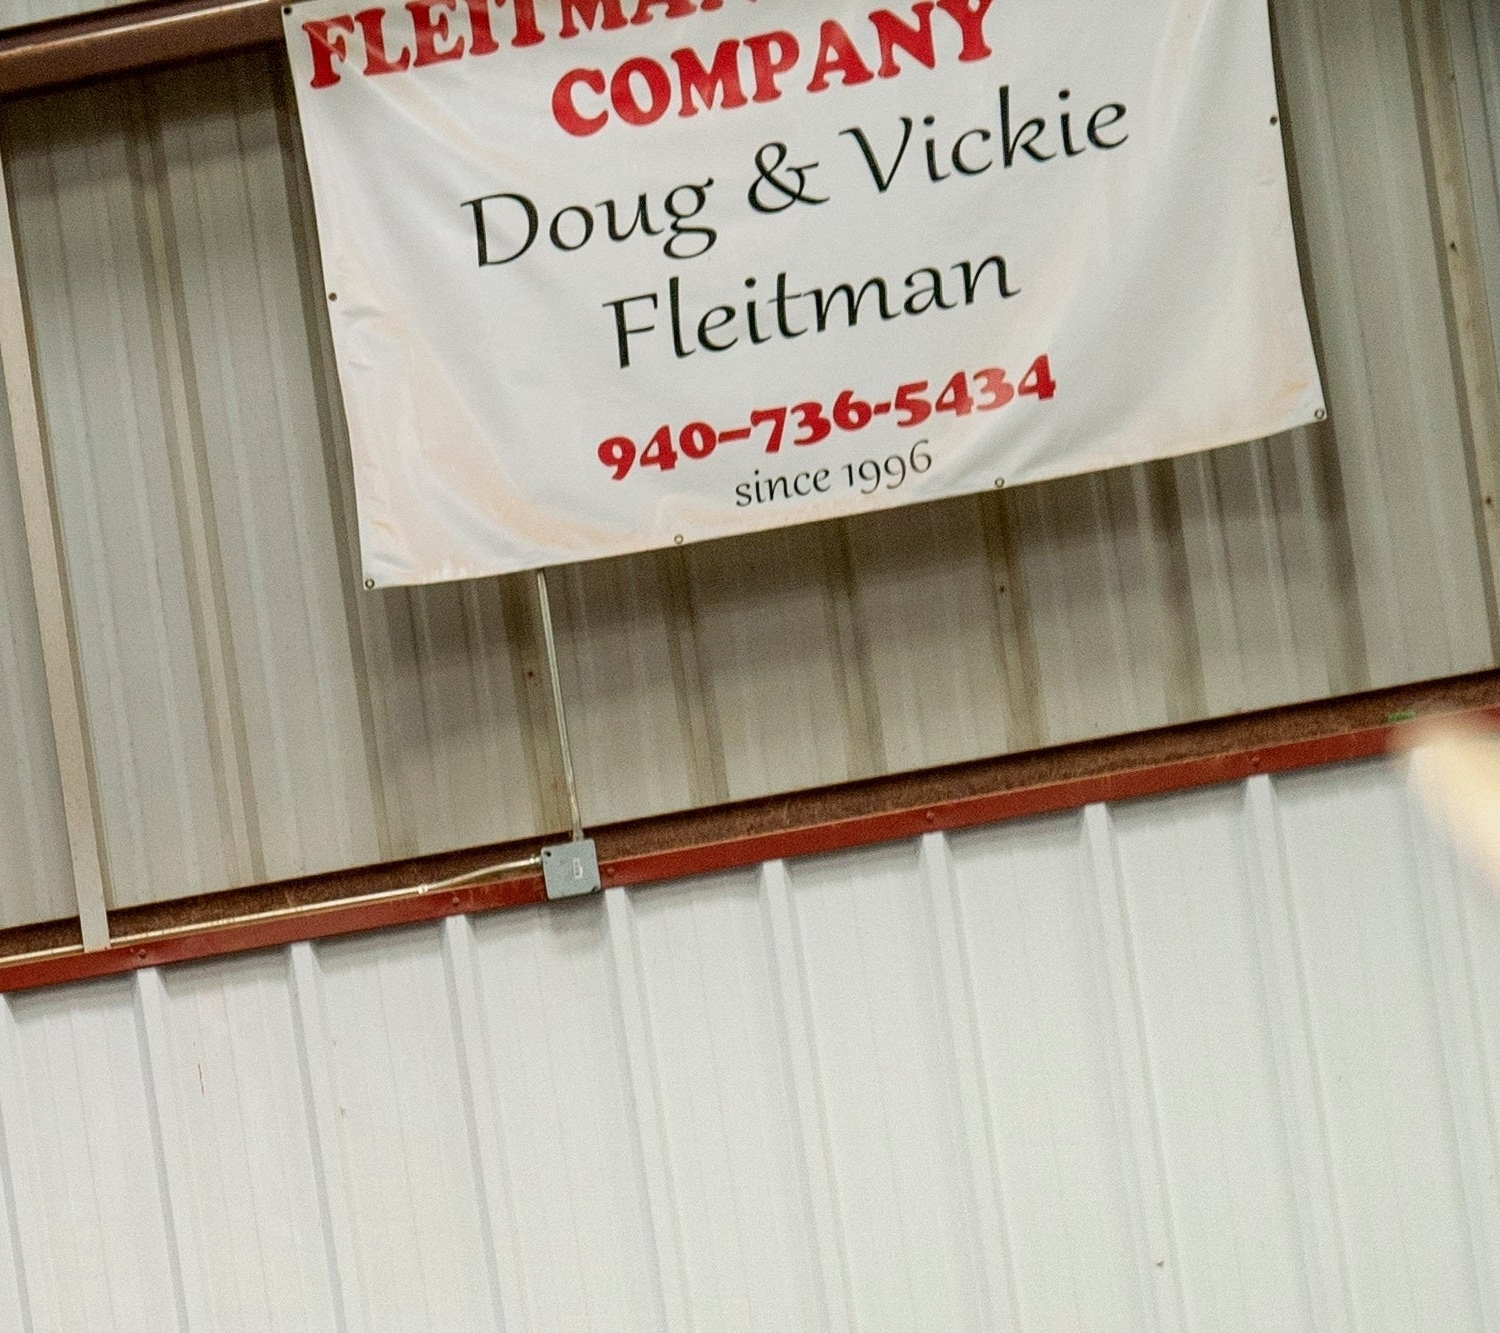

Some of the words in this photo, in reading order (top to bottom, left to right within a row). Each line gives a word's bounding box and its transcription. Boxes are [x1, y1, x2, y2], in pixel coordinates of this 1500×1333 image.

[551, 0, 993, 137] COMPANY
[462, 171, 717, 268] Doug
[746, 140, 831, 215] &
[838, 85, 1131, 194] Vickie
[601, 252, 1022, 368] Fleitman
[597, 354, 1058, 480] 940-736-5434
[734, 460, 833, 508] since
[843, 439, 933, 496] 1996
